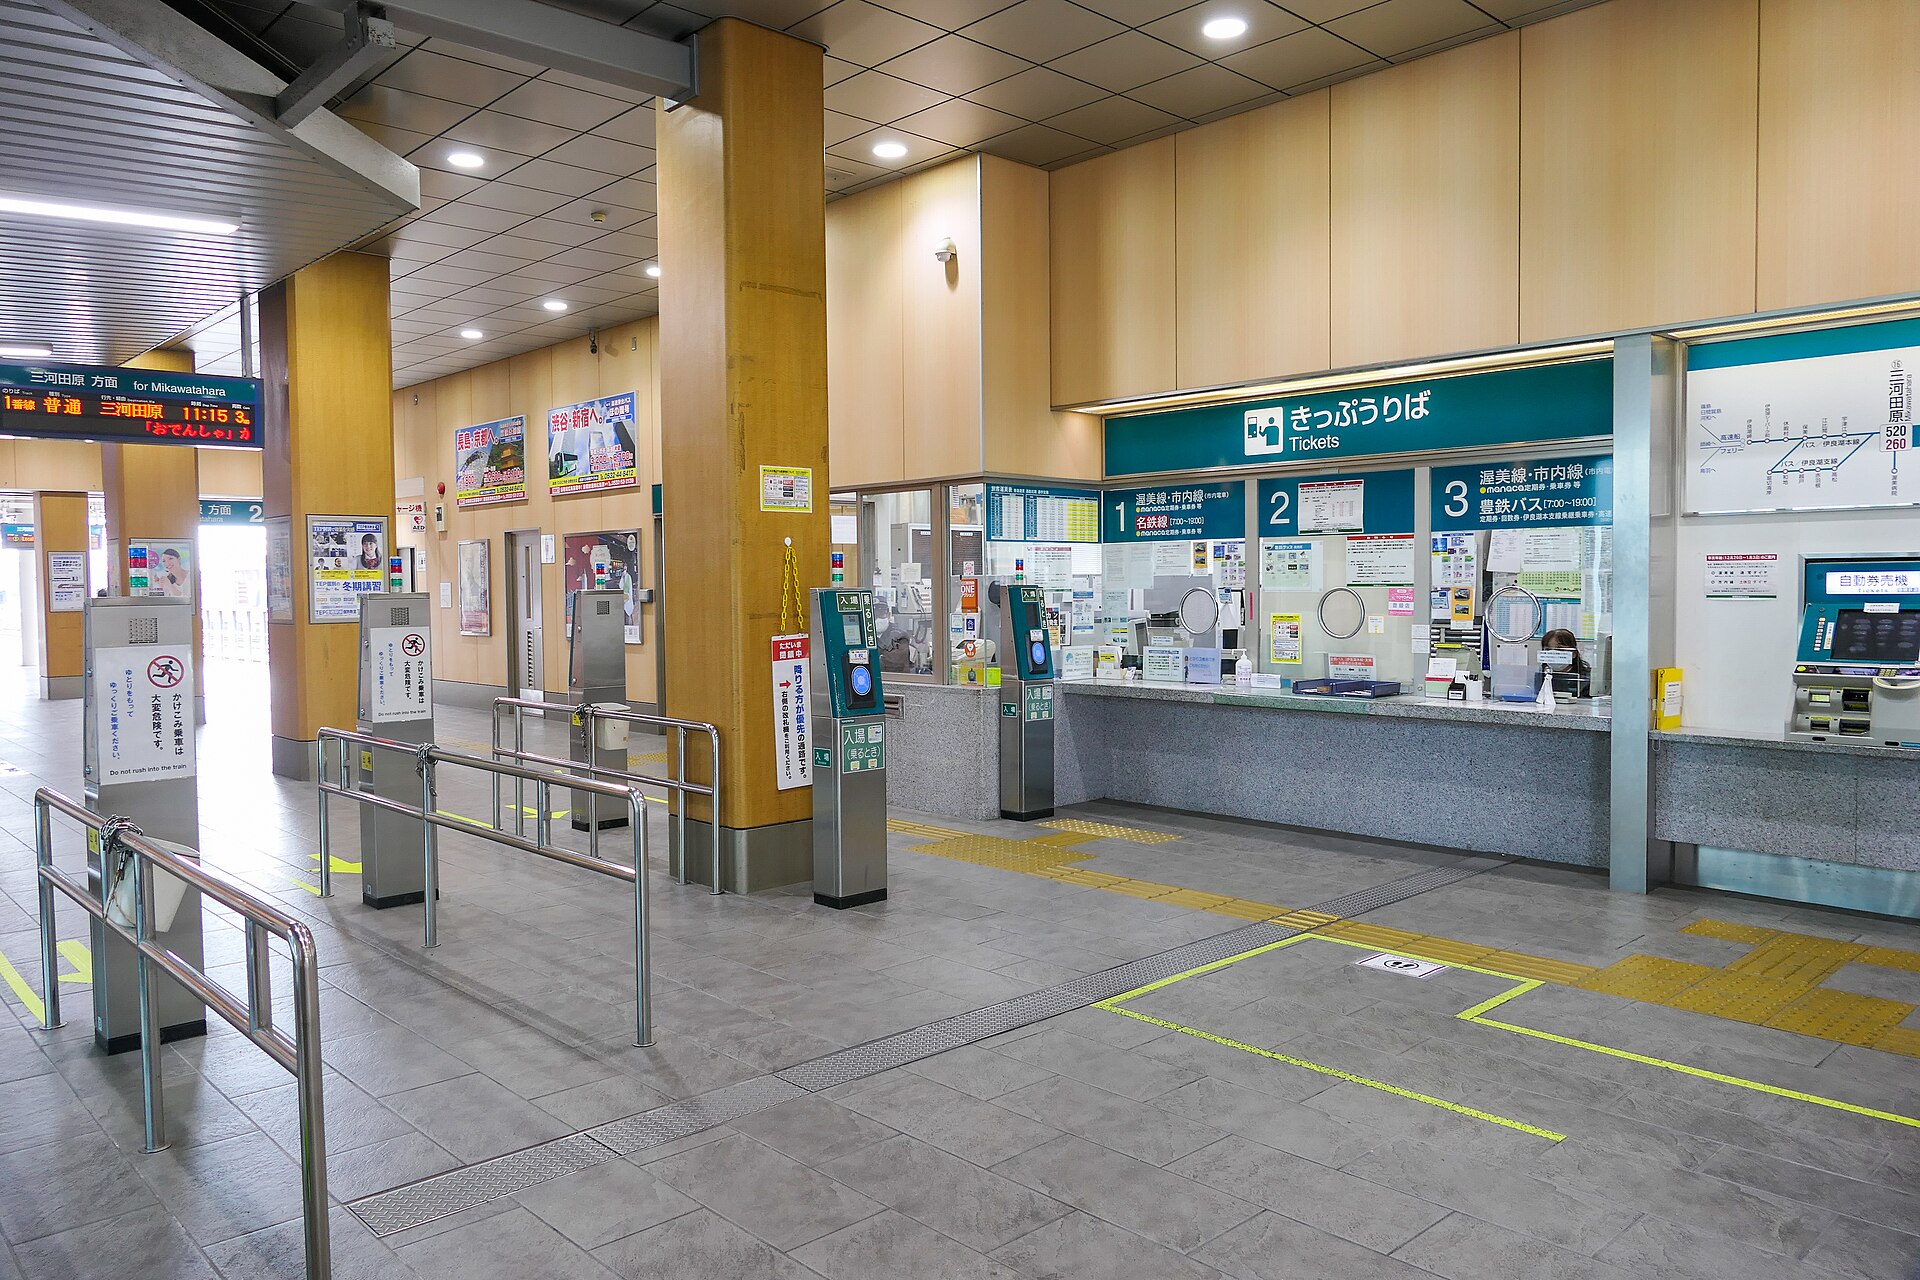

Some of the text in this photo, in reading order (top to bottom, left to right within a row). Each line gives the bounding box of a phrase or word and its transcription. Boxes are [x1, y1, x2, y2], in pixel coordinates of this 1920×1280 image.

[30, 371, 226, 397] 三河田原 方面 for Mikawatahara
[1888, 369, 1905, 423] 三河田原
[4, 395, 36, 411] 1番線
[43, 396, 82, 415] 普通
[100, 402, 163, 419] 三河田原
[182, 407, 228, 422] 11:15
[1290, 389, 1432, 432] きっぷうりば
[1885, 425, 1907, 437] 520
[1289, 434, 1340, 451] Tickets
[1885, 438, 1907, 450] 260
[1444, 480, 1469, 517] 3
[1479, 497, 1543, 515] 豊鉄バス
[208, 504, 232, 515] 方面
[249, 504, 265, 523] 2
[1115, 501, 1125, 532] 1
[1269, 491, 1290, 525] 2
[1136, 515, 1168, 529] 名鉄線
[342, 581, 382, 592] 冬期講習
[961, 585, 975, 593] ONE
[1840, 574, 1908, 587] 自動券売機
[840, 595, 859, 605] 入場
[1023, 590, 1036, 598] 入場
[863, 595, 875, 646] 乗るとき
[779, 641, 802, 650] ただいま
[125, 669, 134, 718] ゆとりをもって
[110, 682, 121, 760] ゆっくりご乗車ください。
[151, 694, 164, 751] 大変危険です。
[172, 693, 184, 756] かけこみ乗車は
[844, 728, 865, 745] 入場
